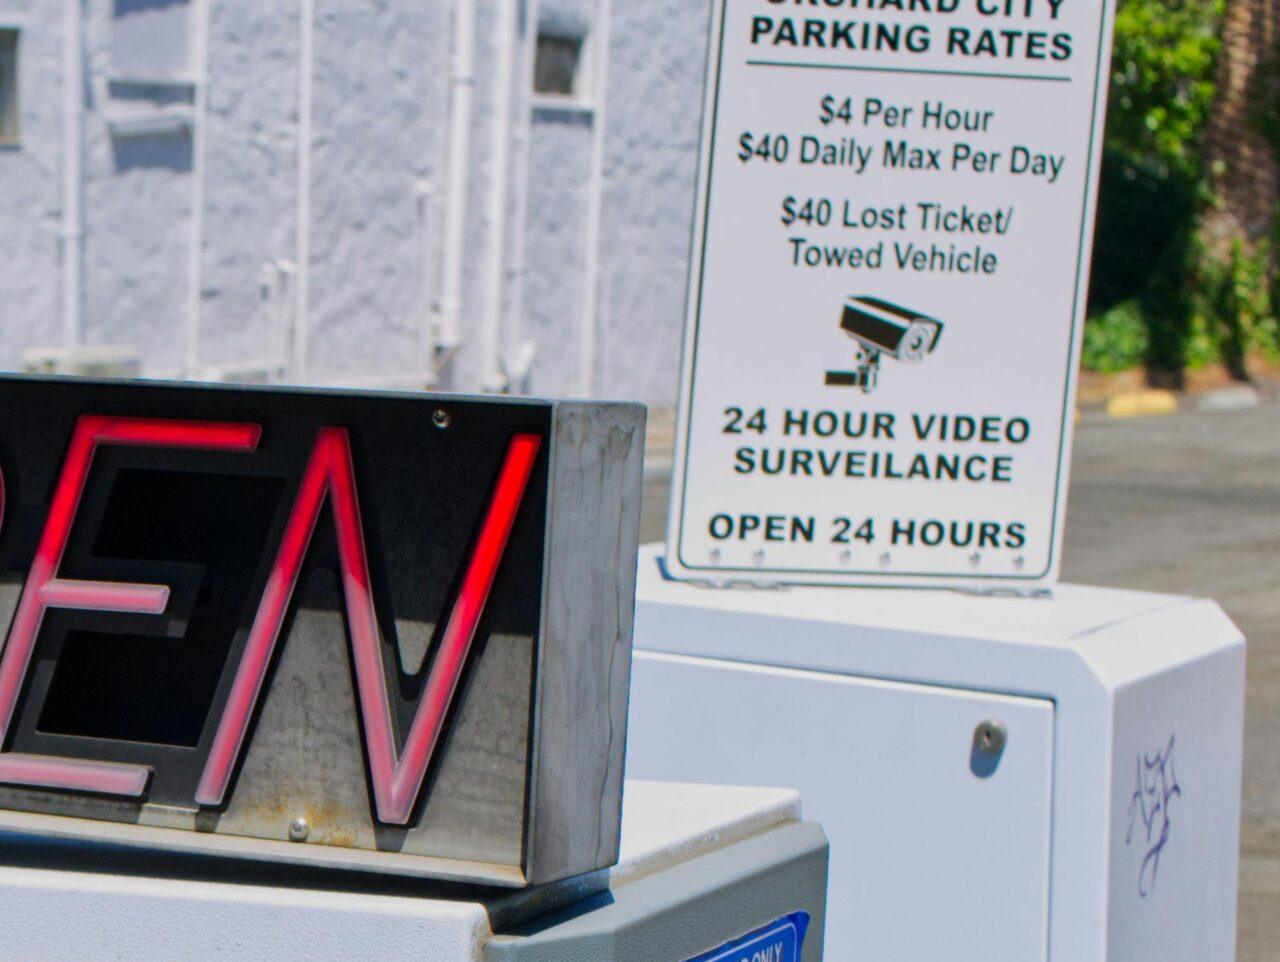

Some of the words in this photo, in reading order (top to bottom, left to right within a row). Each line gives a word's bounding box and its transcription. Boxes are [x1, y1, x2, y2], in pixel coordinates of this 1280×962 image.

[751, 16, 930, 53] PARKING
[947, 27, 1073, 61] RATES
[819, 95, 852, 126] $4
[863, 99, 912, 128] Per
[922, 101, 993, 132] Hour
[738, 132, 789, 163] $40
[800, 135, 872, 174] Daily
[883, 140, 940, 170] Max
[952, 144, 1001, 173] Per
[1010, 146, 1065, 183] Day
[781, 196, 832, 227] $40
[842, 200, 907, 231] Lost
[918, 203, 1013, 235] Ticket/
[789, 237, 883, 269] Towed
[894, 242, 998, 274] Vehicle
[723, 407, 767, 435] 24
[783, 410, 896, 439] HOUR
[912, 414, 1031, 444] VIDEO
[733, 447, 1013, 483] SURVEILANCE
[708, 513, 815, 543] OPEN
[831, 517, 875, 544] 24
[890, 519, 1026, 549] HOURS
